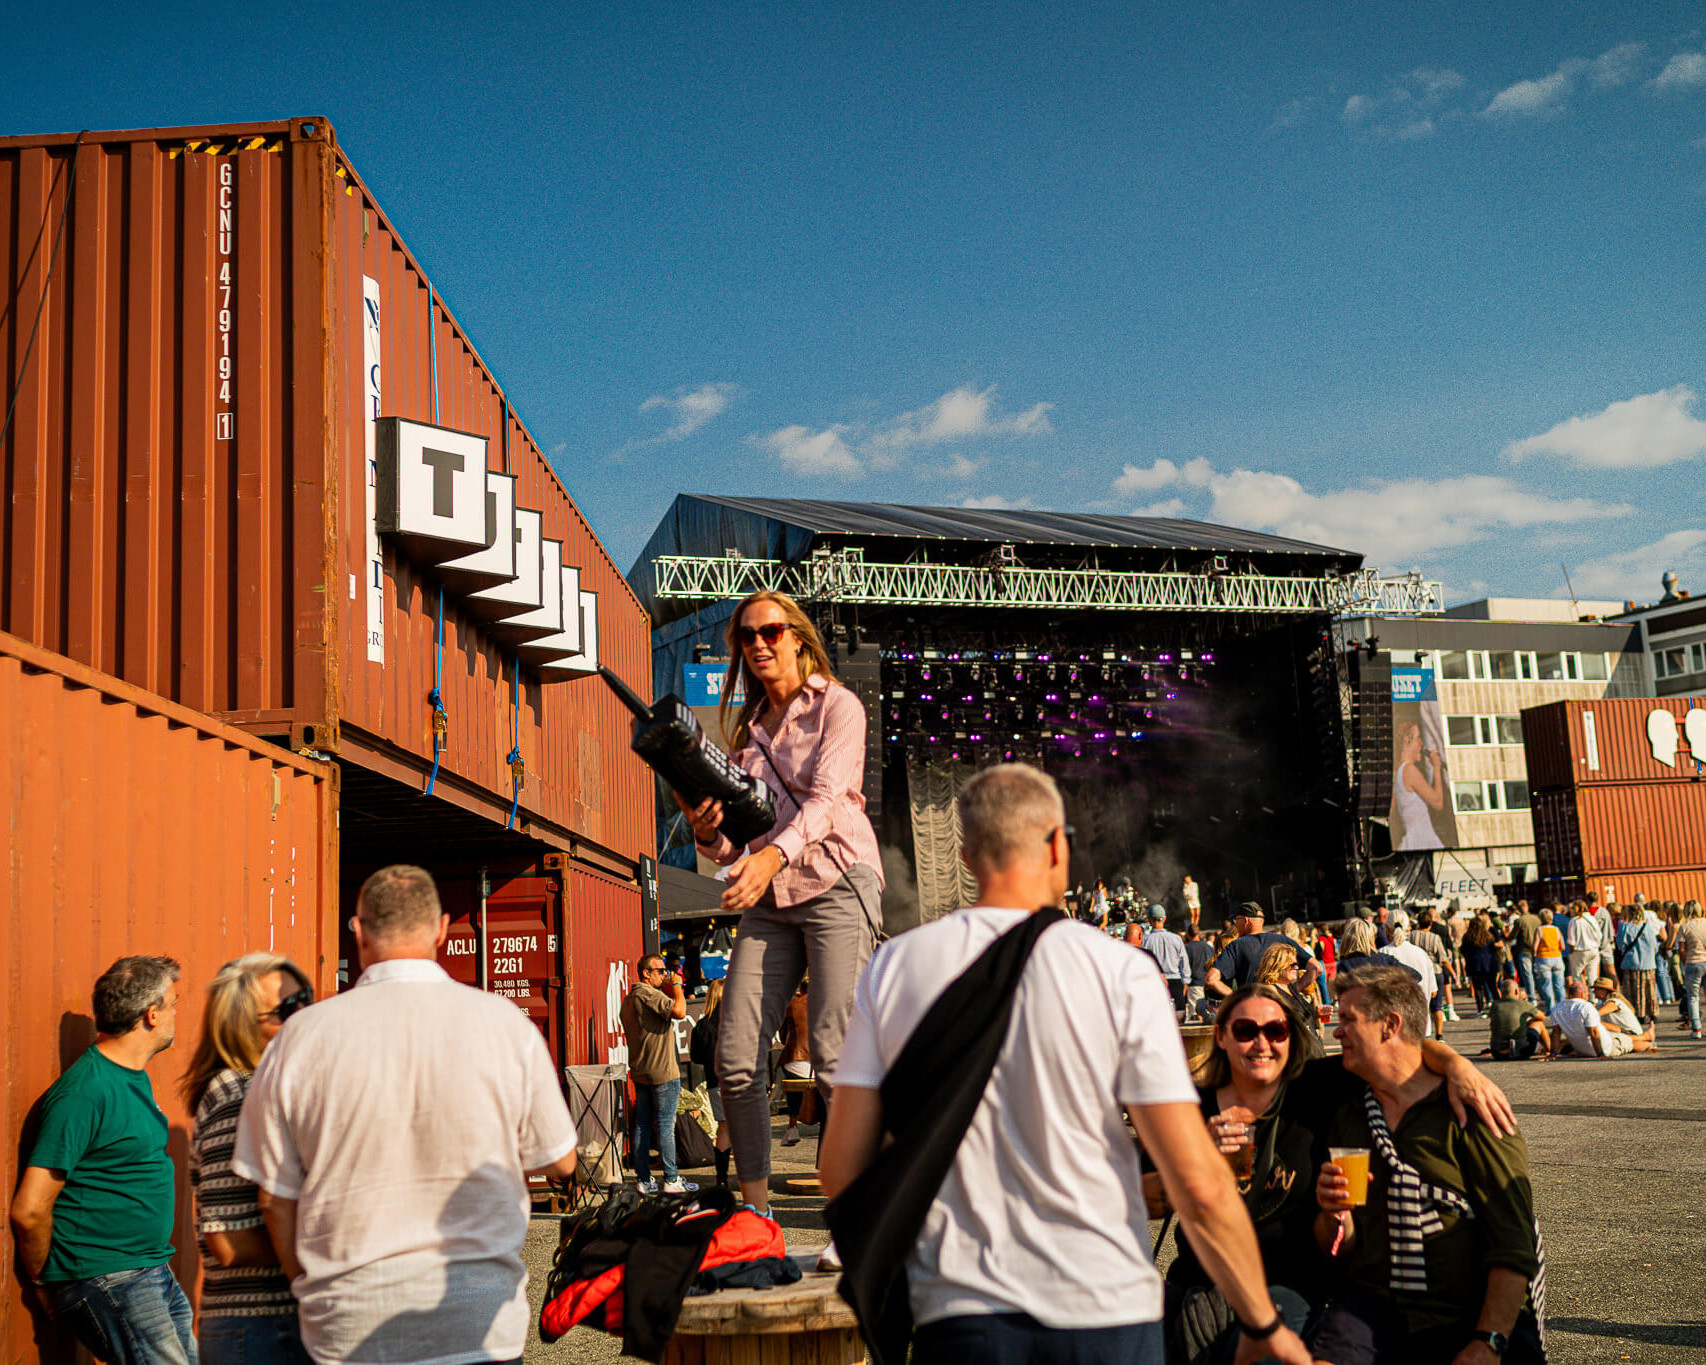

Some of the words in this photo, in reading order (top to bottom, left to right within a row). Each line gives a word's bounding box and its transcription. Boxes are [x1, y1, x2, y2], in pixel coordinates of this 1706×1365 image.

[220, 163, 232, 254] GCNU
[219, 262, 231, 403] 479194
[1441, 879, 1488, 896] FLEET
[446, 939, 477, 955] ACLU
[493, 936, 537, 953] 279674
[548, 934, 558, 952] 5
[494, 957, 523, 973] 22G1
[517, 988, 531, 997] LBS.
